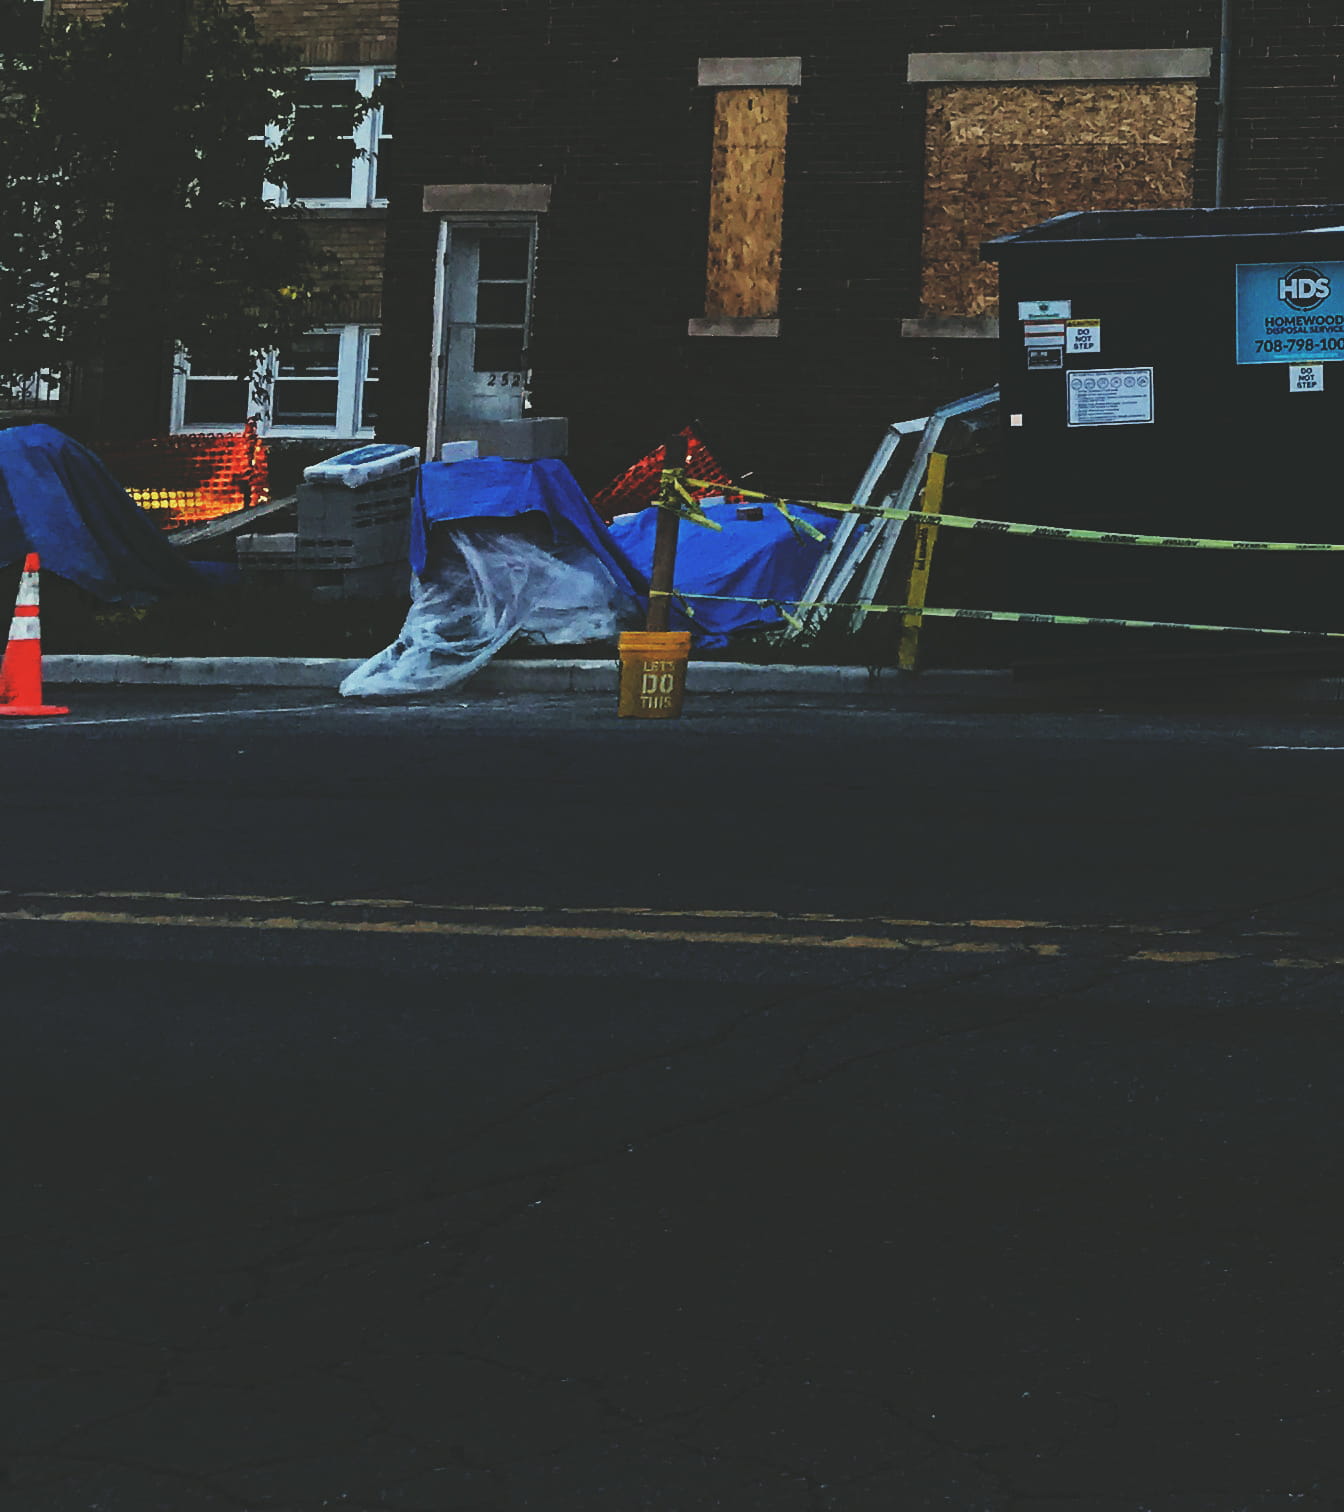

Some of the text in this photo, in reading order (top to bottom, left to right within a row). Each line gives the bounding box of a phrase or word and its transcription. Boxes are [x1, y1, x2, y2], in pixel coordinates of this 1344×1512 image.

[1279, 277, 1330, 299] HDS
[1265, 315, 1344, 327] HOMEWOOD
[1266, 325, 1344, 335] DISPOSAL SERVICE
[1075, 335, 1092, 343] NOT
[1073, 342, 1094, 350] STEP
[1296, 381, 1317, 389] STEP
[642, 673, 674, 694] DO
[640, 695, 671, 709] THIS
